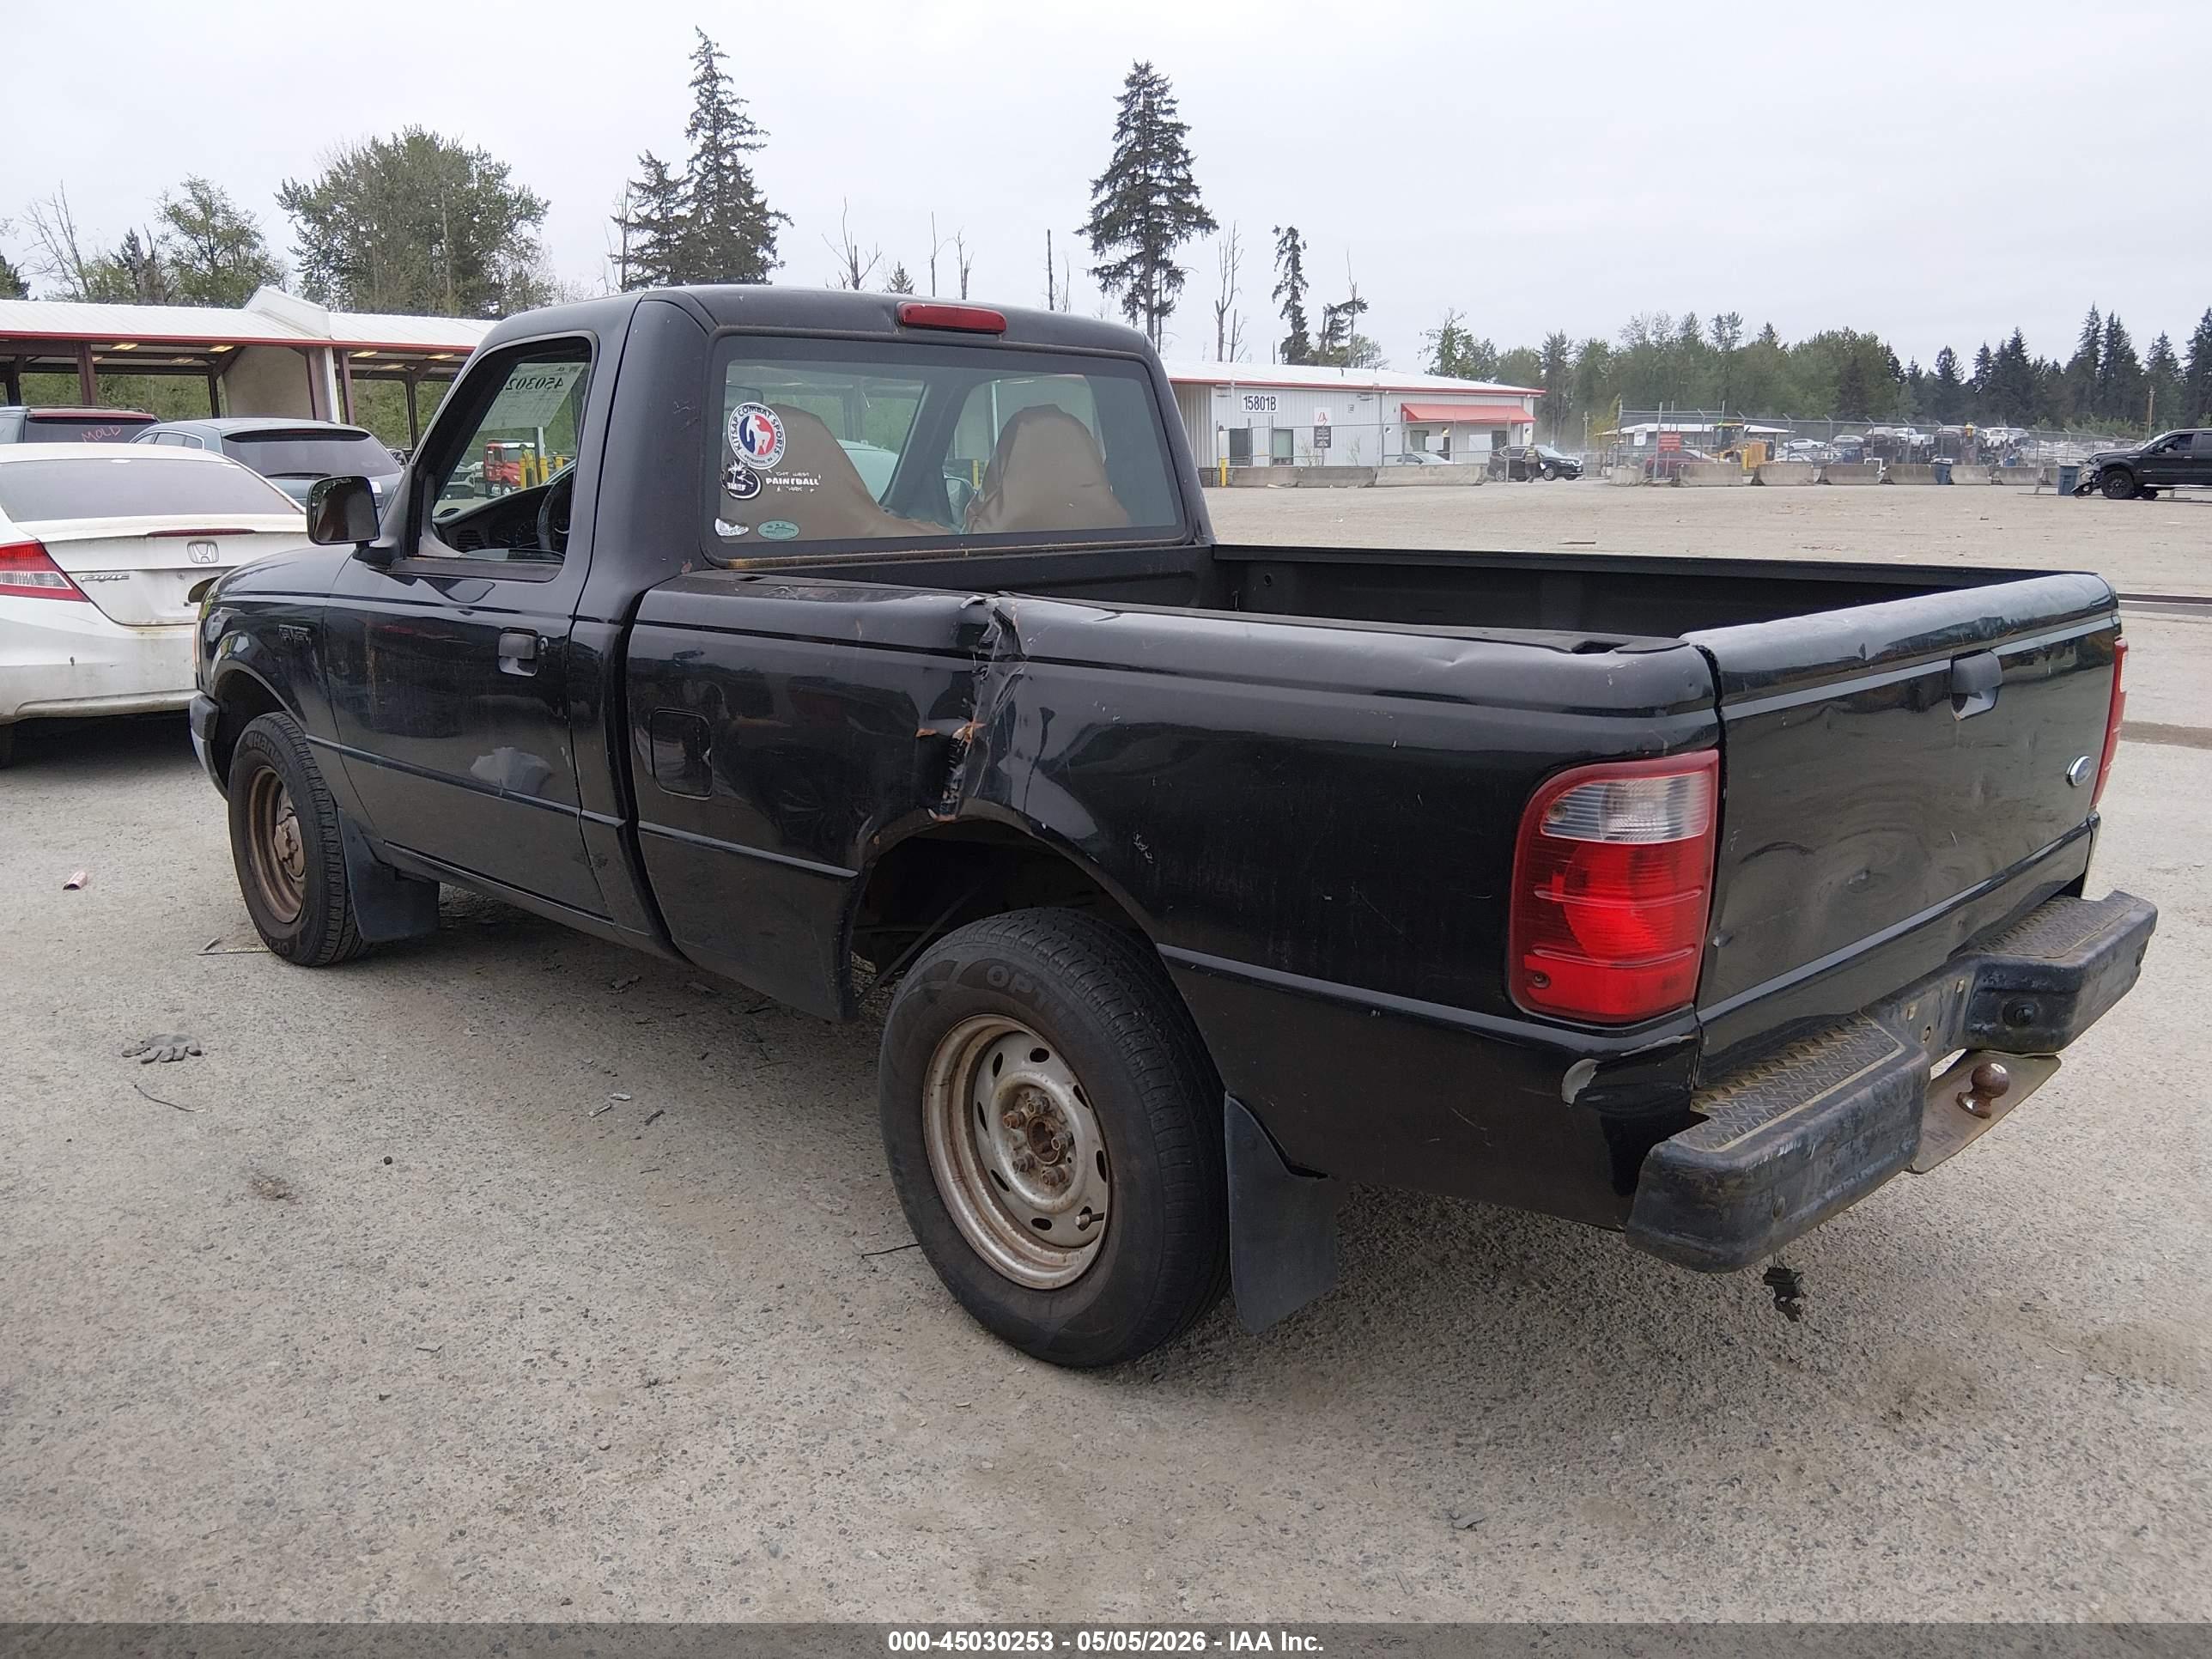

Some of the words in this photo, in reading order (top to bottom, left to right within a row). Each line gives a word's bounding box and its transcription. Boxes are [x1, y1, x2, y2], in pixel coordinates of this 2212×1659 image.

[1243, 395, 1277, 411] 15801B
[82, 426, 122, 443] MOLD
[731, 416, 743, 451] KITSAP
[738, 405, 773, 419] COMBAT
[771, 418, 783, 455] SPORTS
[765, 477, 820, 486] PAINTBALL
